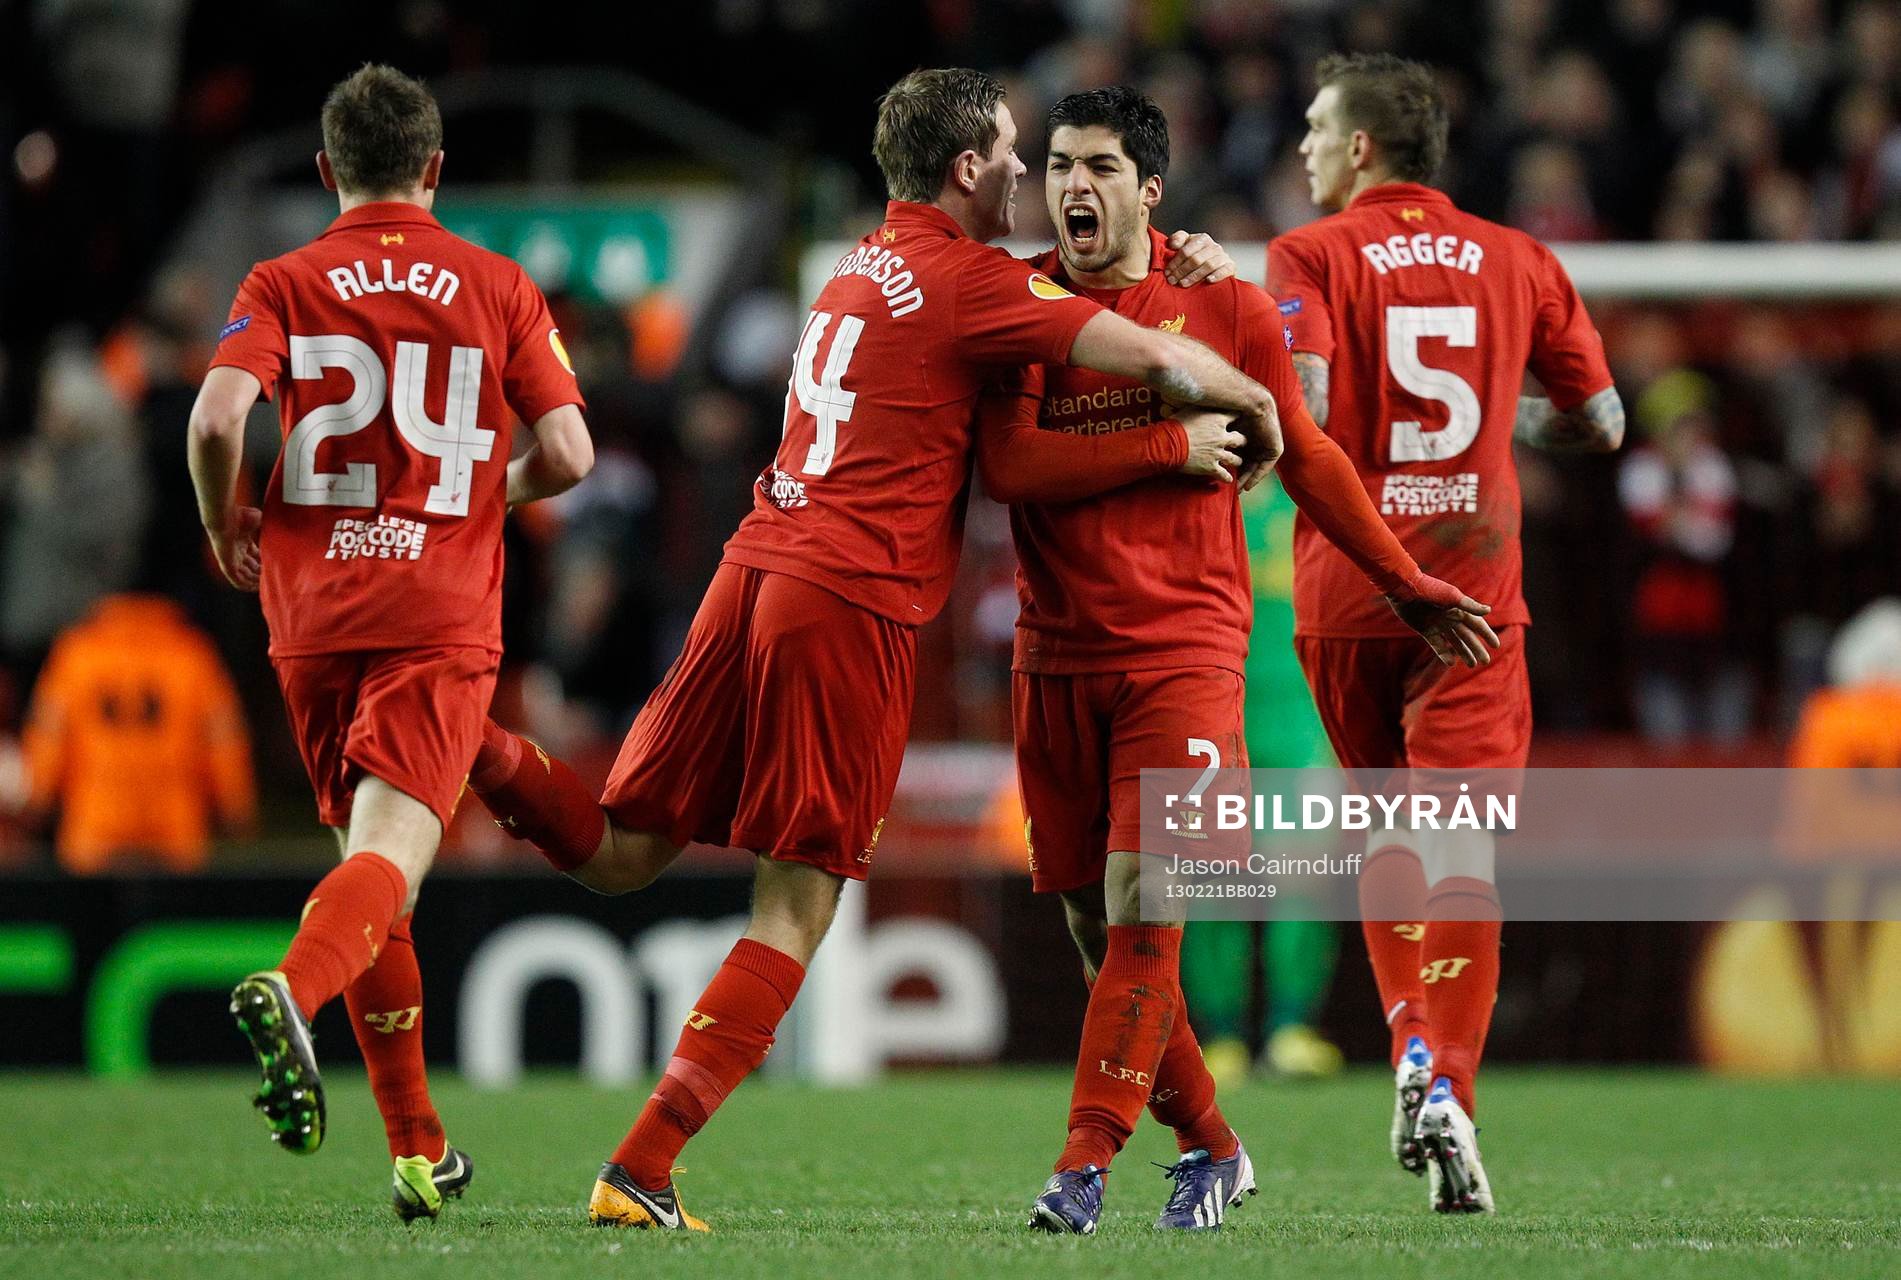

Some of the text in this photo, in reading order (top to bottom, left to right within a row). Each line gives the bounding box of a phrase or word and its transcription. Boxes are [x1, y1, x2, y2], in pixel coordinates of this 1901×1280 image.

[1361, 232, 1484, 275] AGGER
[327, 258, 461, 306] ALLEN
[832, 245, 924, 319] NDERSON
[773, 310, 866, 476] 4
[1385, 305, 1482, 462] 5
[283, 334, 496, 517] 24
[1381, 484, 1478, 505] POSTCODE
[1396, 501, 1463, 516] TRUST
[1099, 1060, 1150, 1088] L.F.C.
